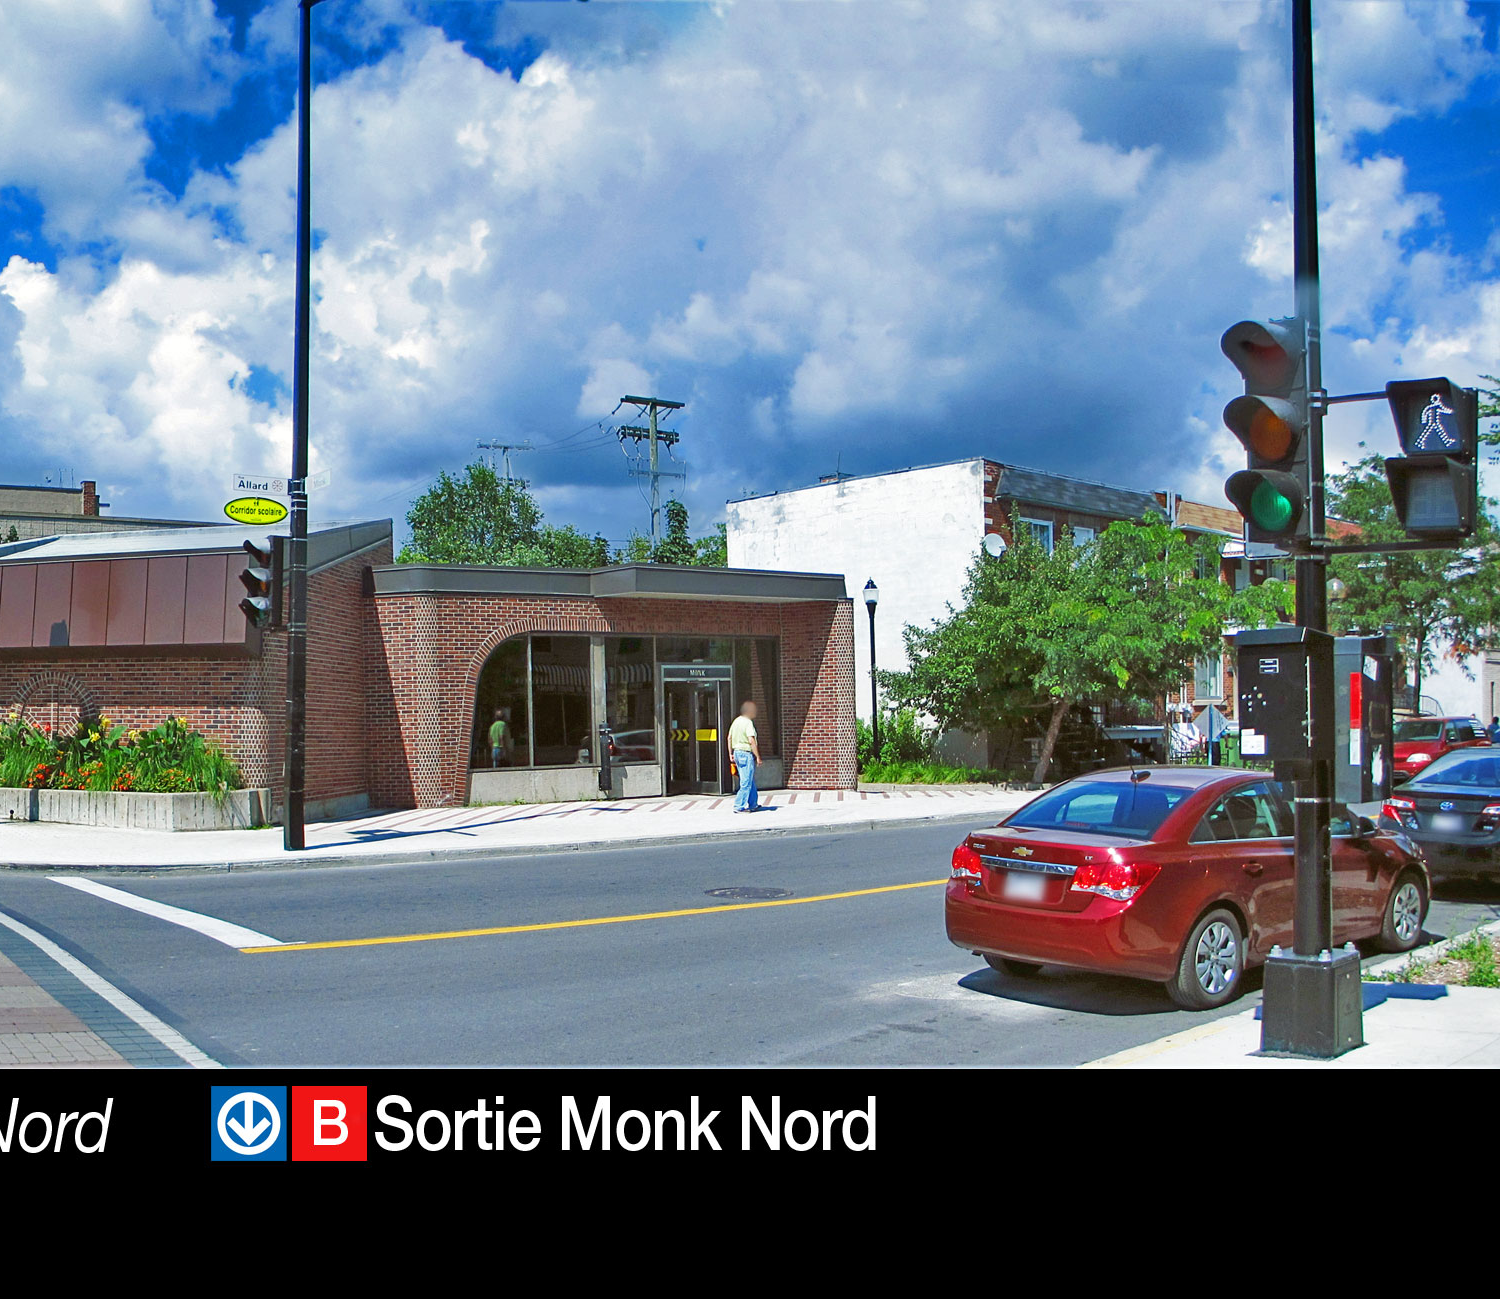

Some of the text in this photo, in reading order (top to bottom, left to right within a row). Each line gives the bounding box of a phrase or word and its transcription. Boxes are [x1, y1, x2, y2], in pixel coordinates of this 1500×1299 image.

[238, 480, 268, 491] Allard
[230, 505, 283, 516] Corridor scolaire
